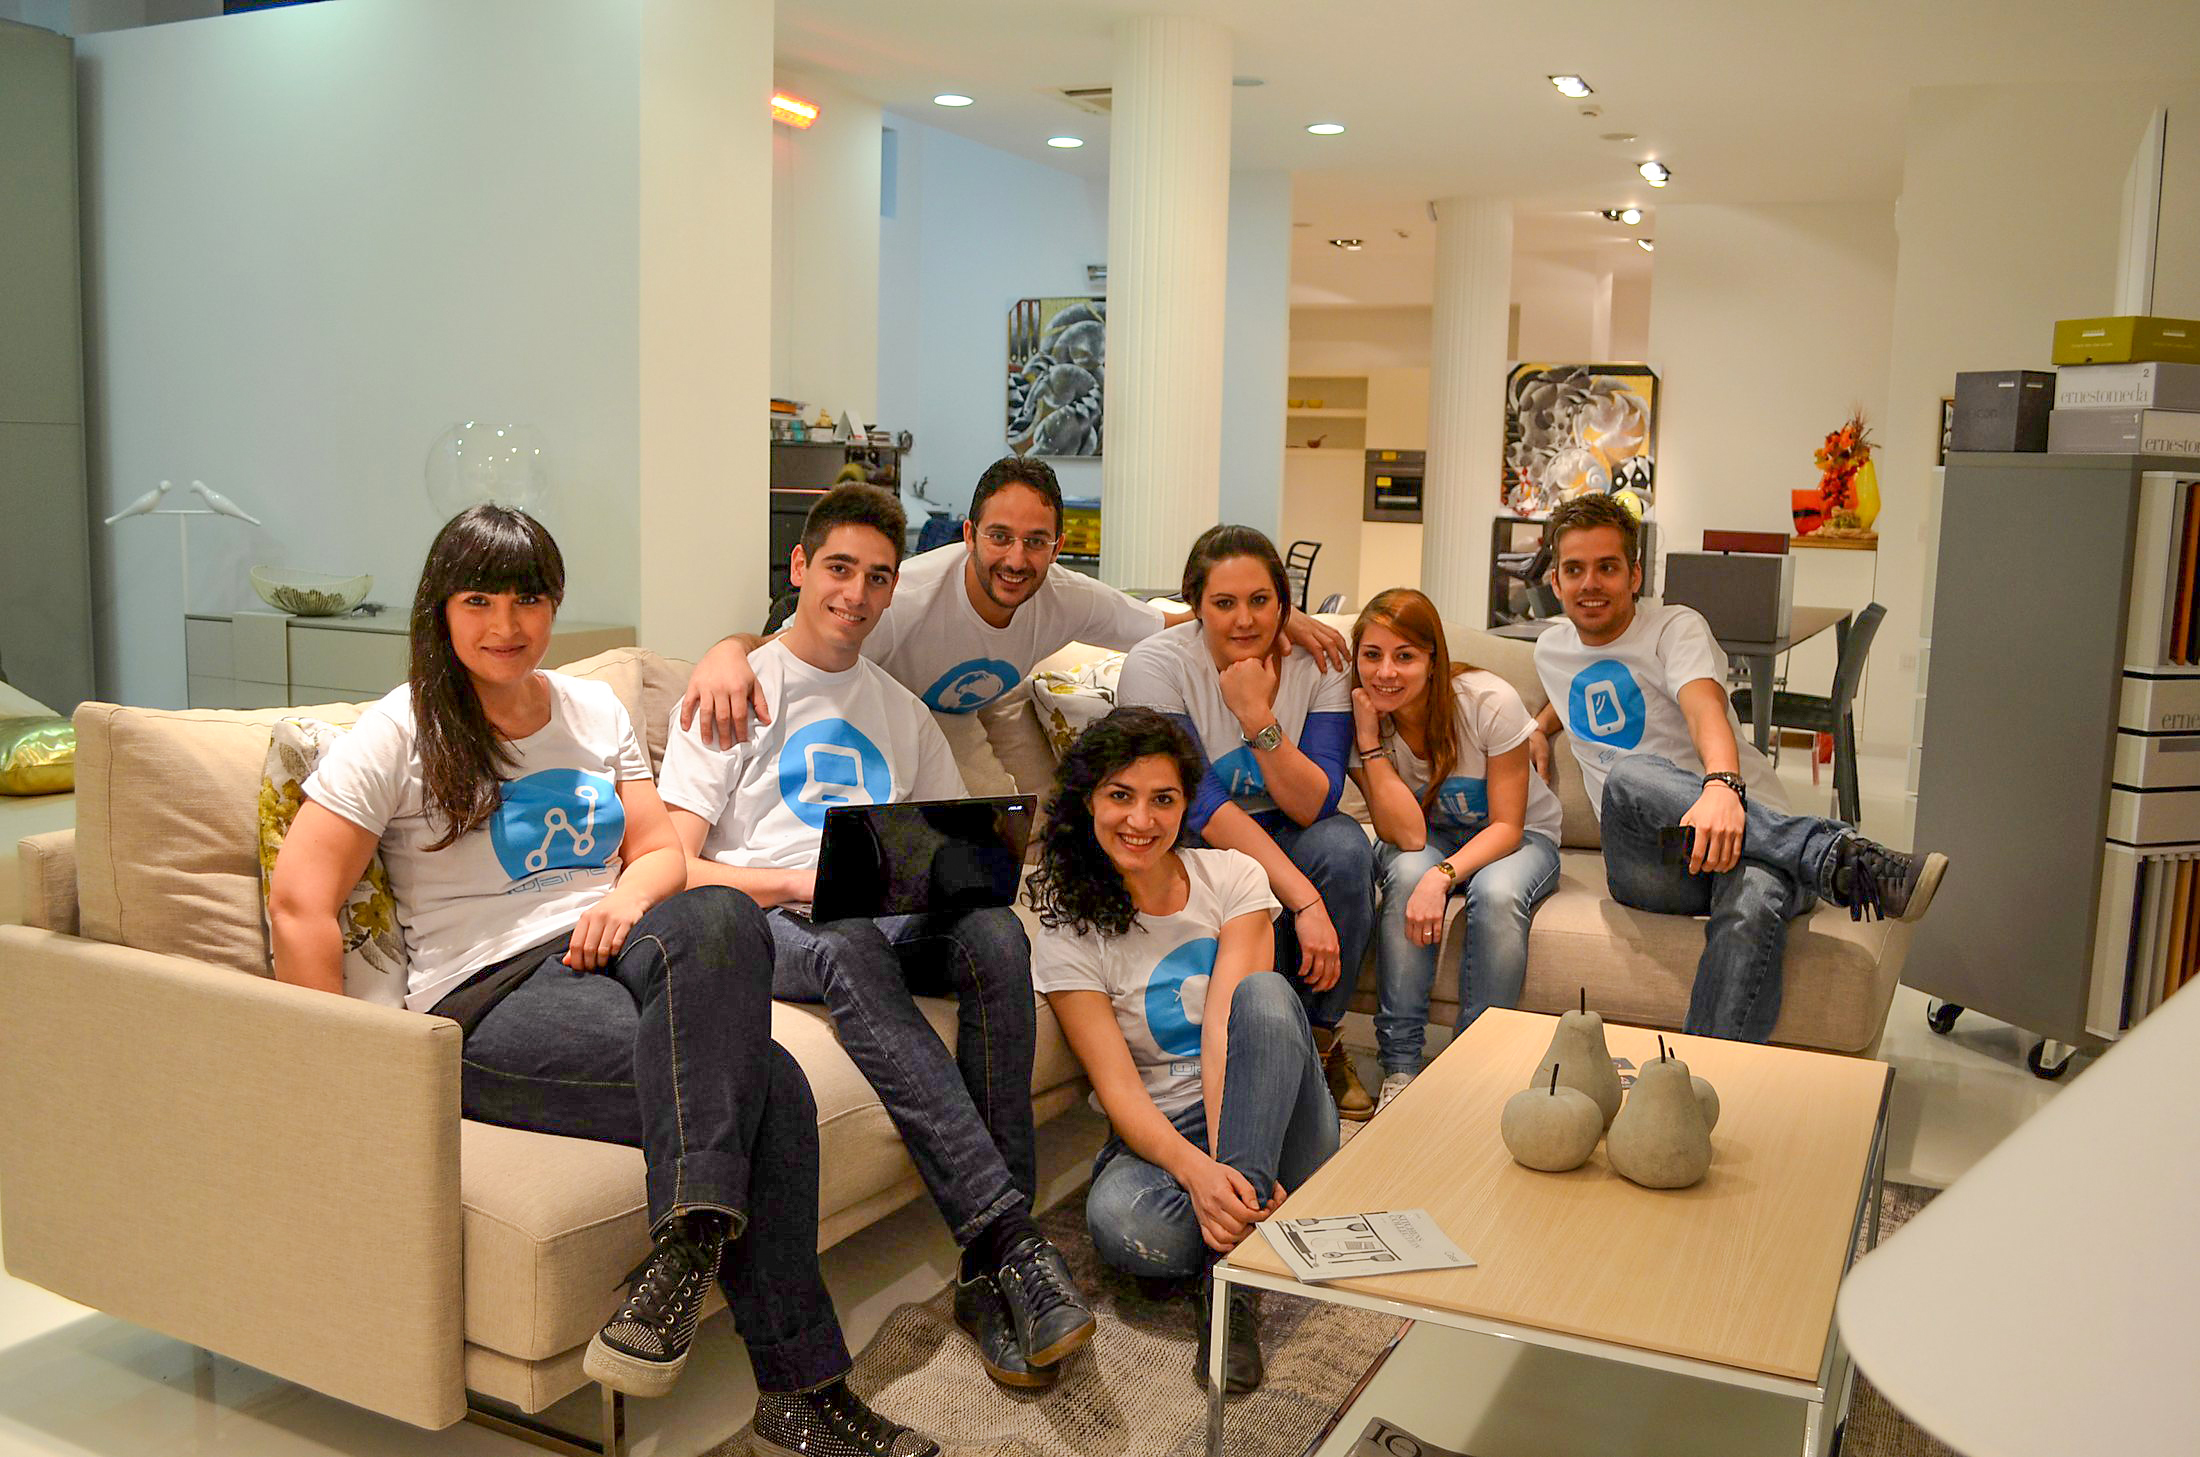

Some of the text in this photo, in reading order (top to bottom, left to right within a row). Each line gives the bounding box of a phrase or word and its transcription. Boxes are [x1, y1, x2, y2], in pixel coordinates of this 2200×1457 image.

[2143, 368, 2150, 378] 2
[2060, 382, 2149, 405] ernestomeda
[2133, 413, 2139, 424] 1
